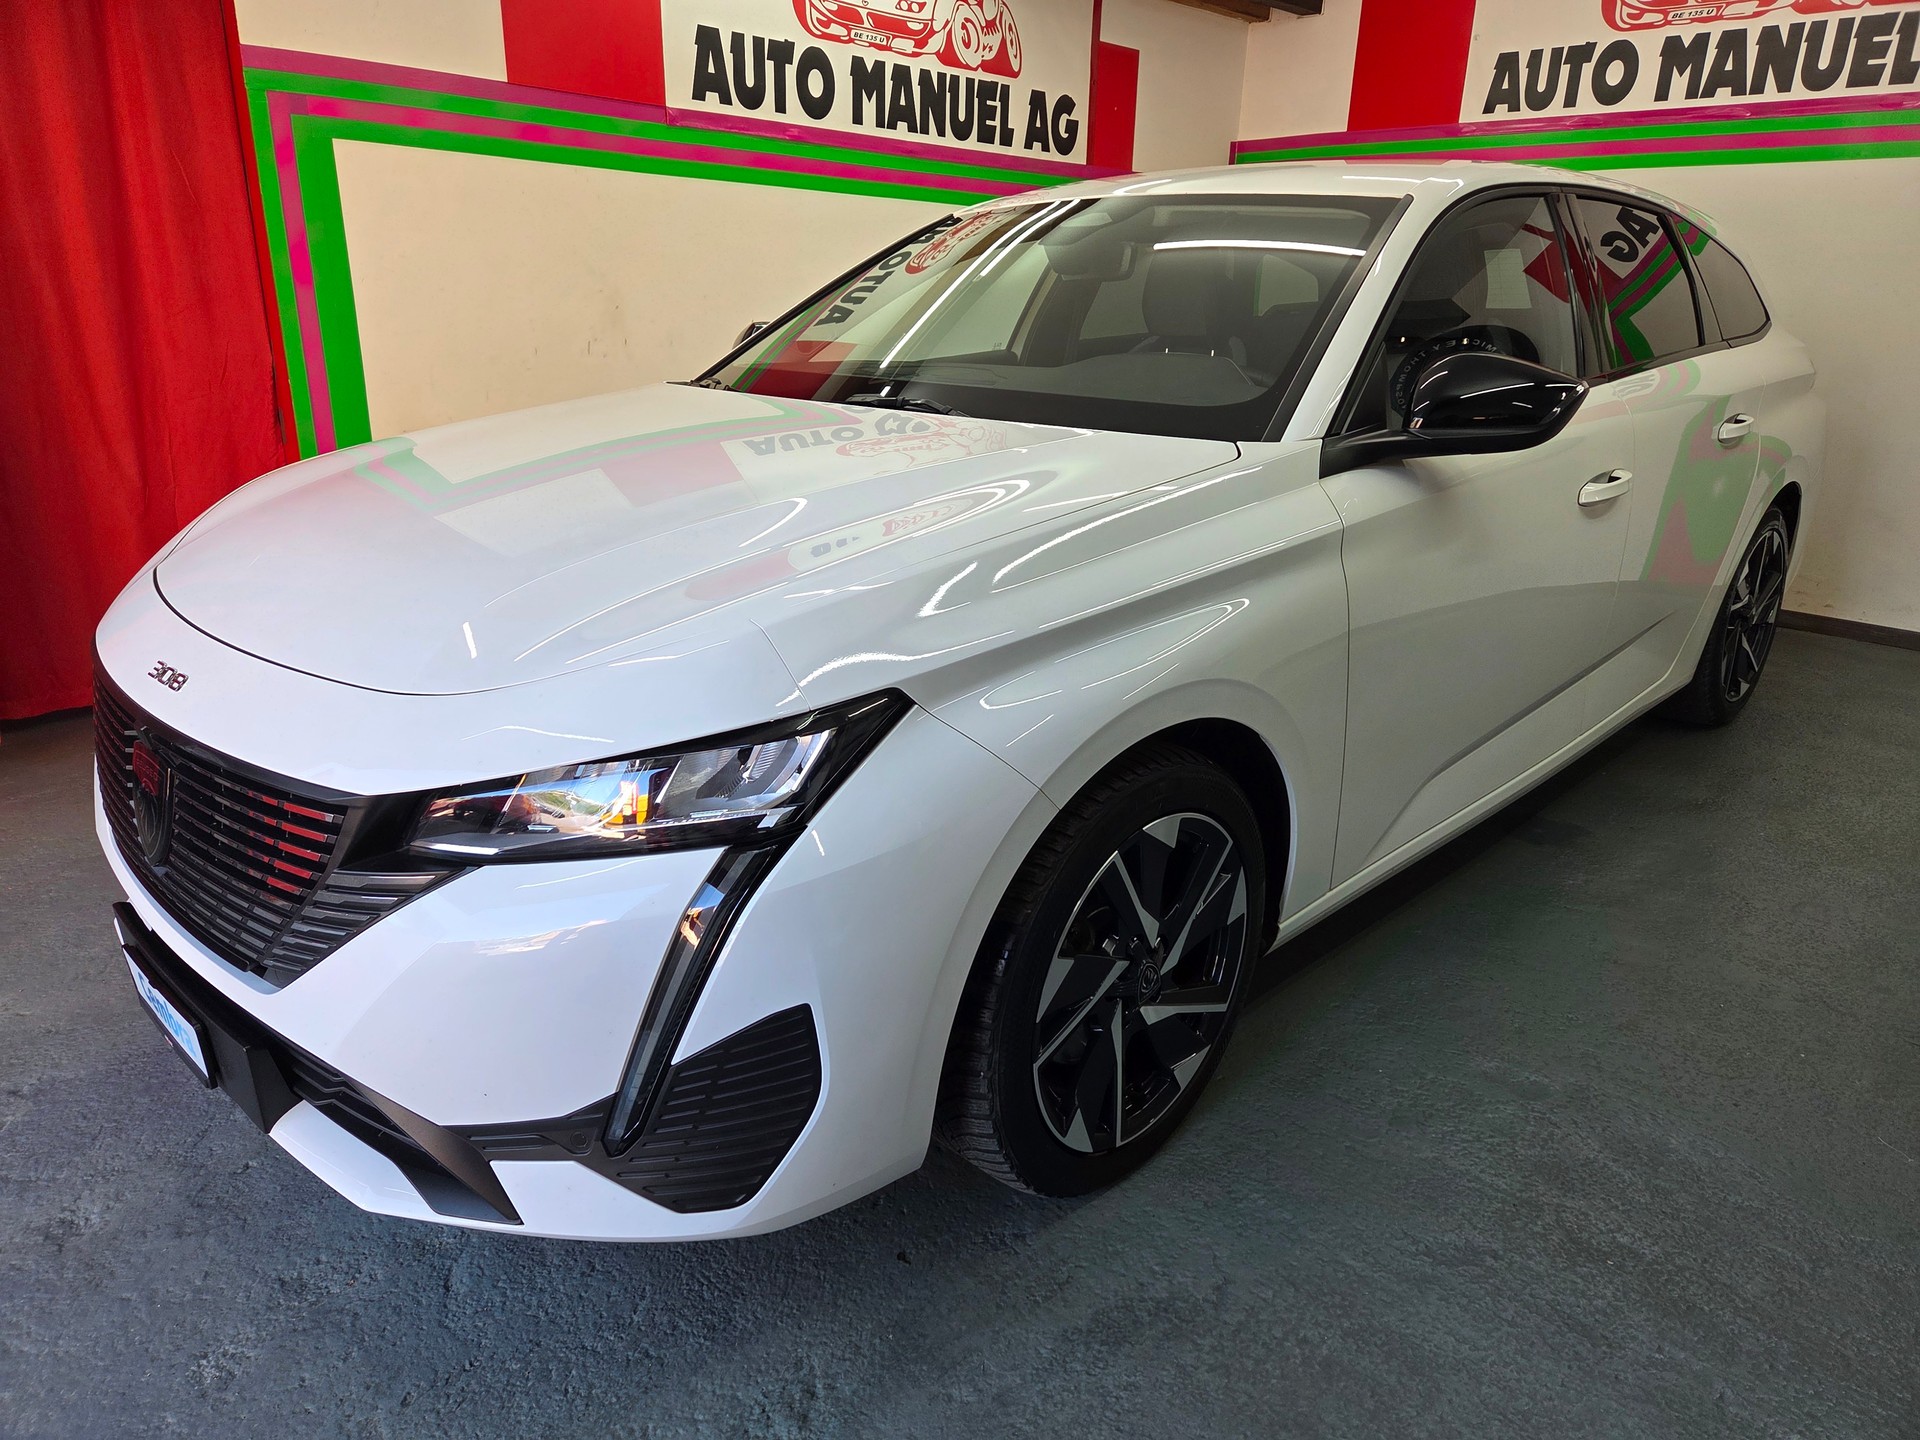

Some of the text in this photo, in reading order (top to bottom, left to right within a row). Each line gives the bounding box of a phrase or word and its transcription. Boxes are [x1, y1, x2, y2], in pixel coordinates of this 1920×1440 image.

[1671, 11, 1685, 19] BE
[853, 31, 864, 39] BE
[865, 34, 878, 42] 135
[1482, 10, 1920, 114] AUTO MANUEL
[691, 23, 1079, 156] AUTO MANUEL AG
[147, 660, 189, 692] 308
